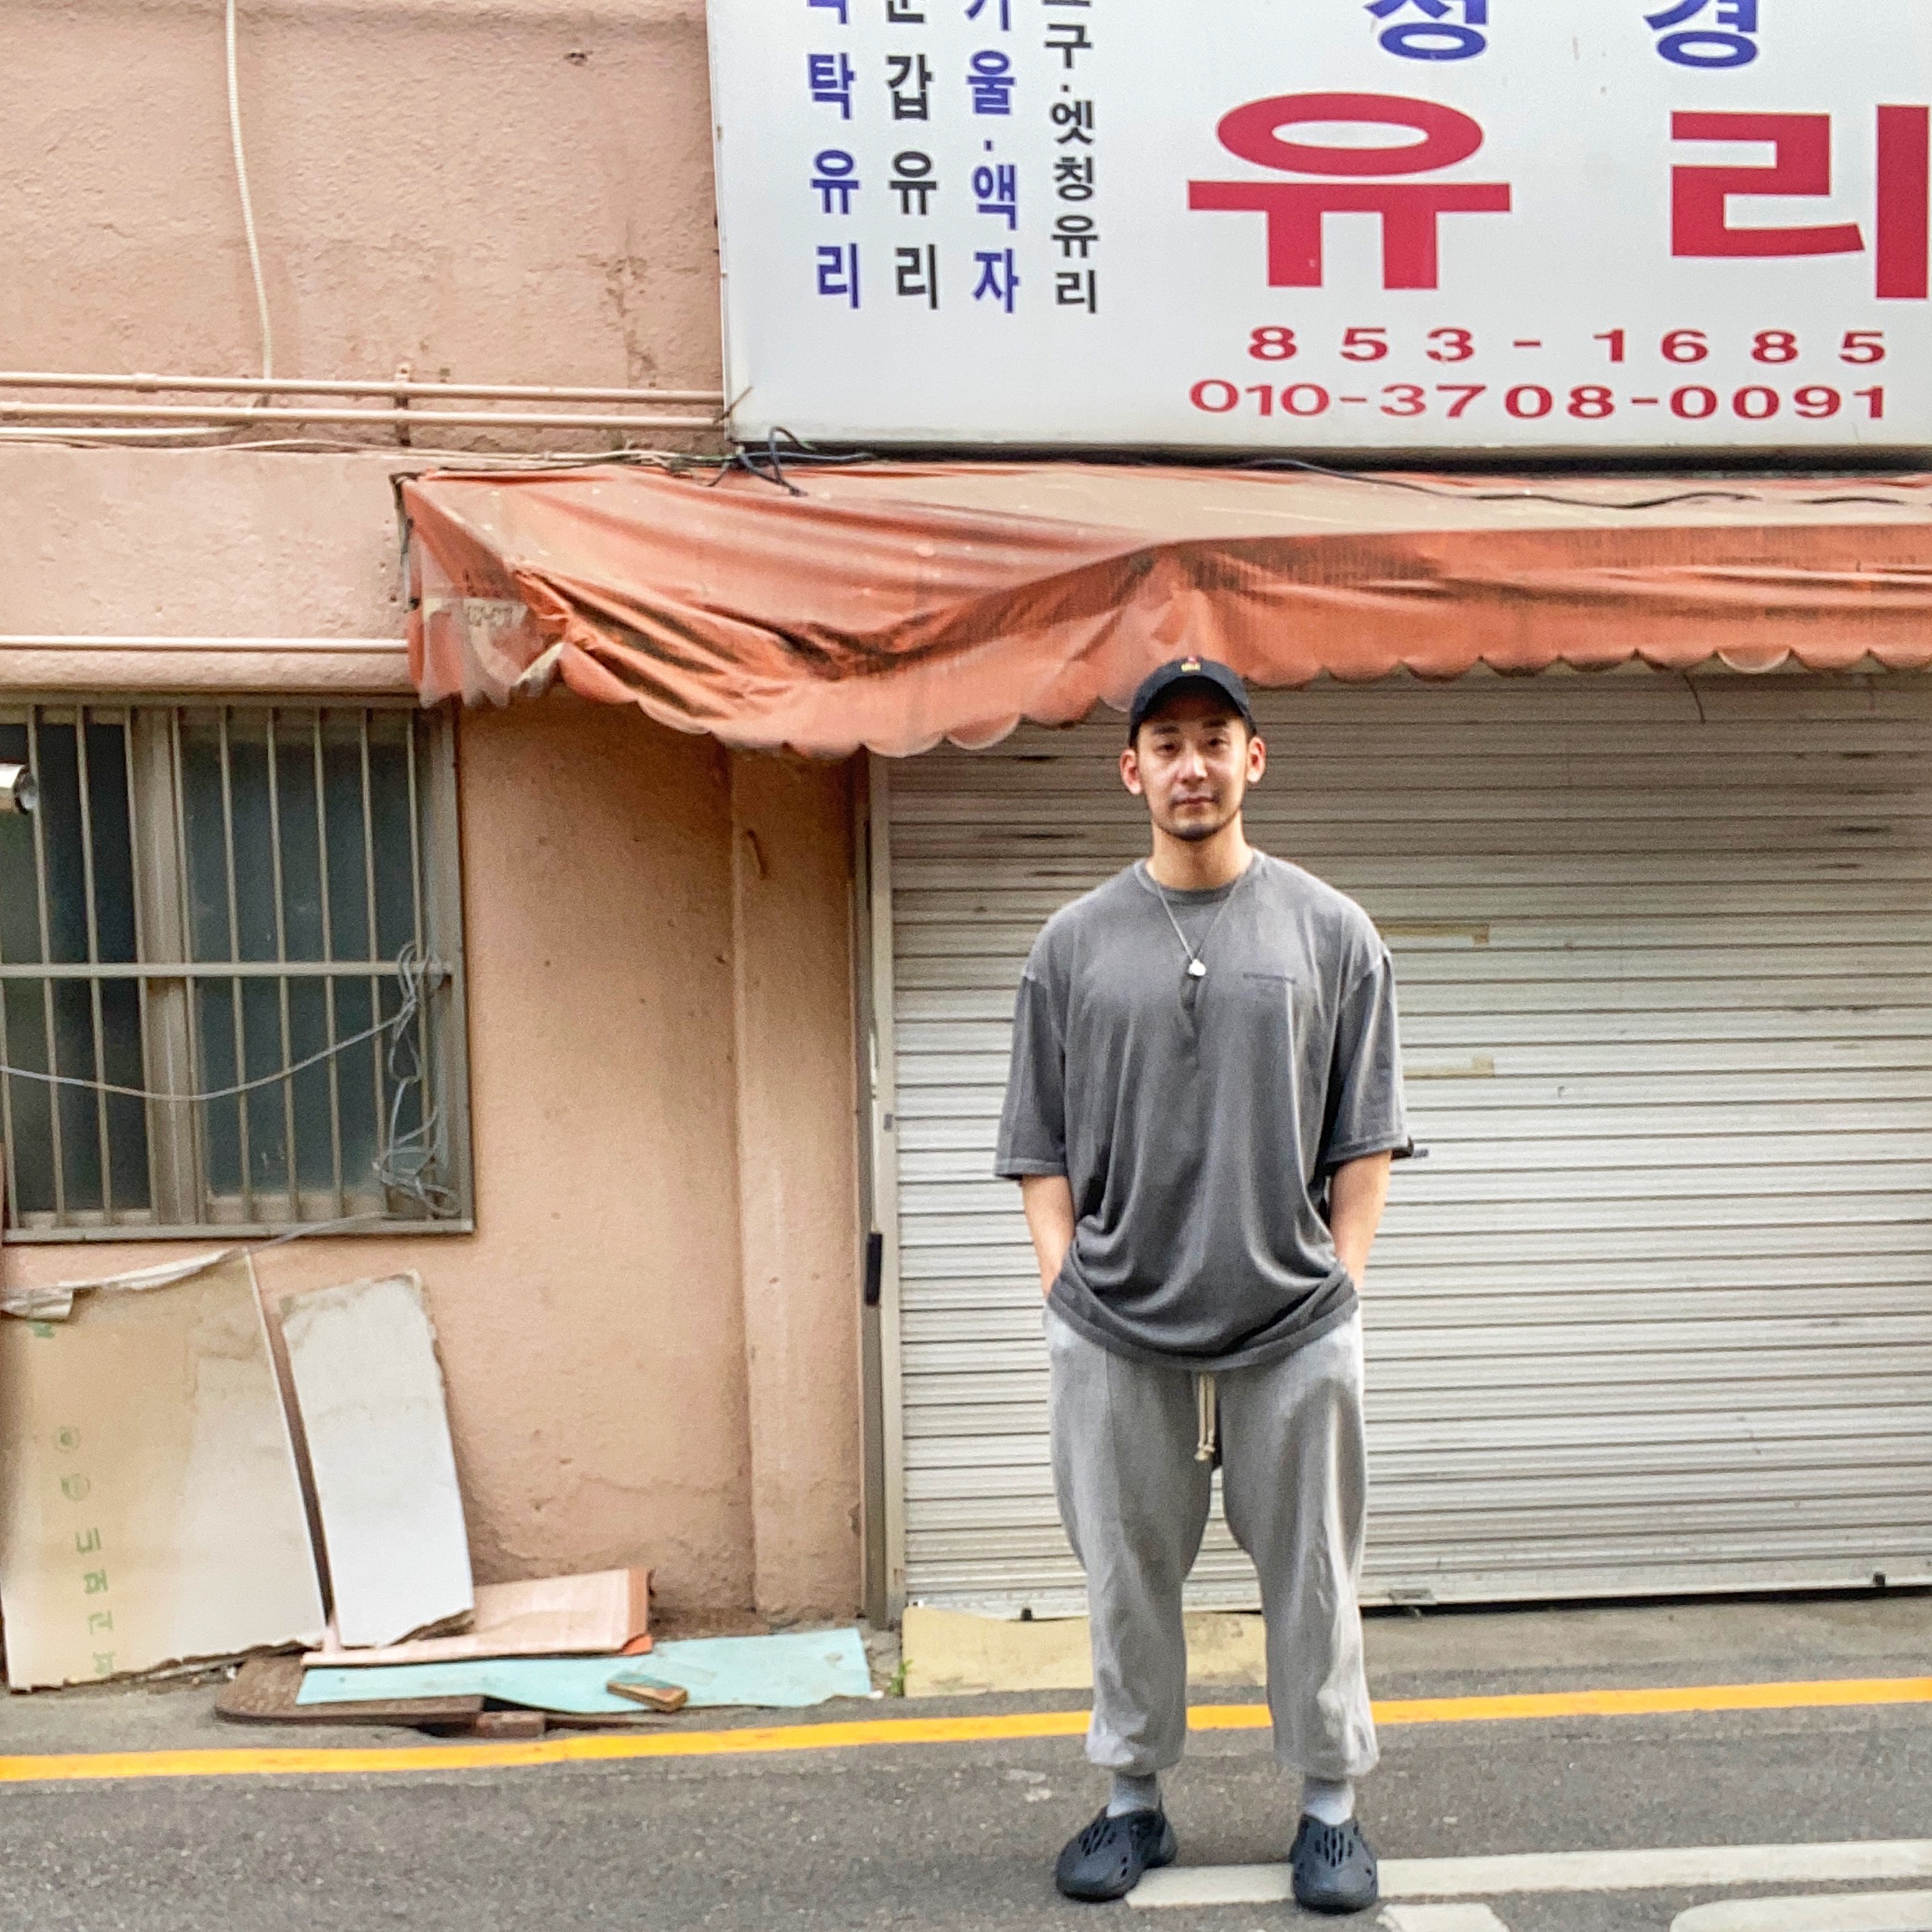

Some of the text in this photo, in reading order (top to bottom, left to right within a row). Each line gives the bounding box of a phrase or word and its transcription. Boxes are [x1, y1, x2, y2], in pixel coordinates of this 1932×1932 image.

[1042, 0, 1099, 314] 구·엣칭유리
[1188, 92, 1930, 300] 유리
[1190, 379, 1885, 420] 010-3708-0091
[1248, 326, 1886, 365] 853-1685
